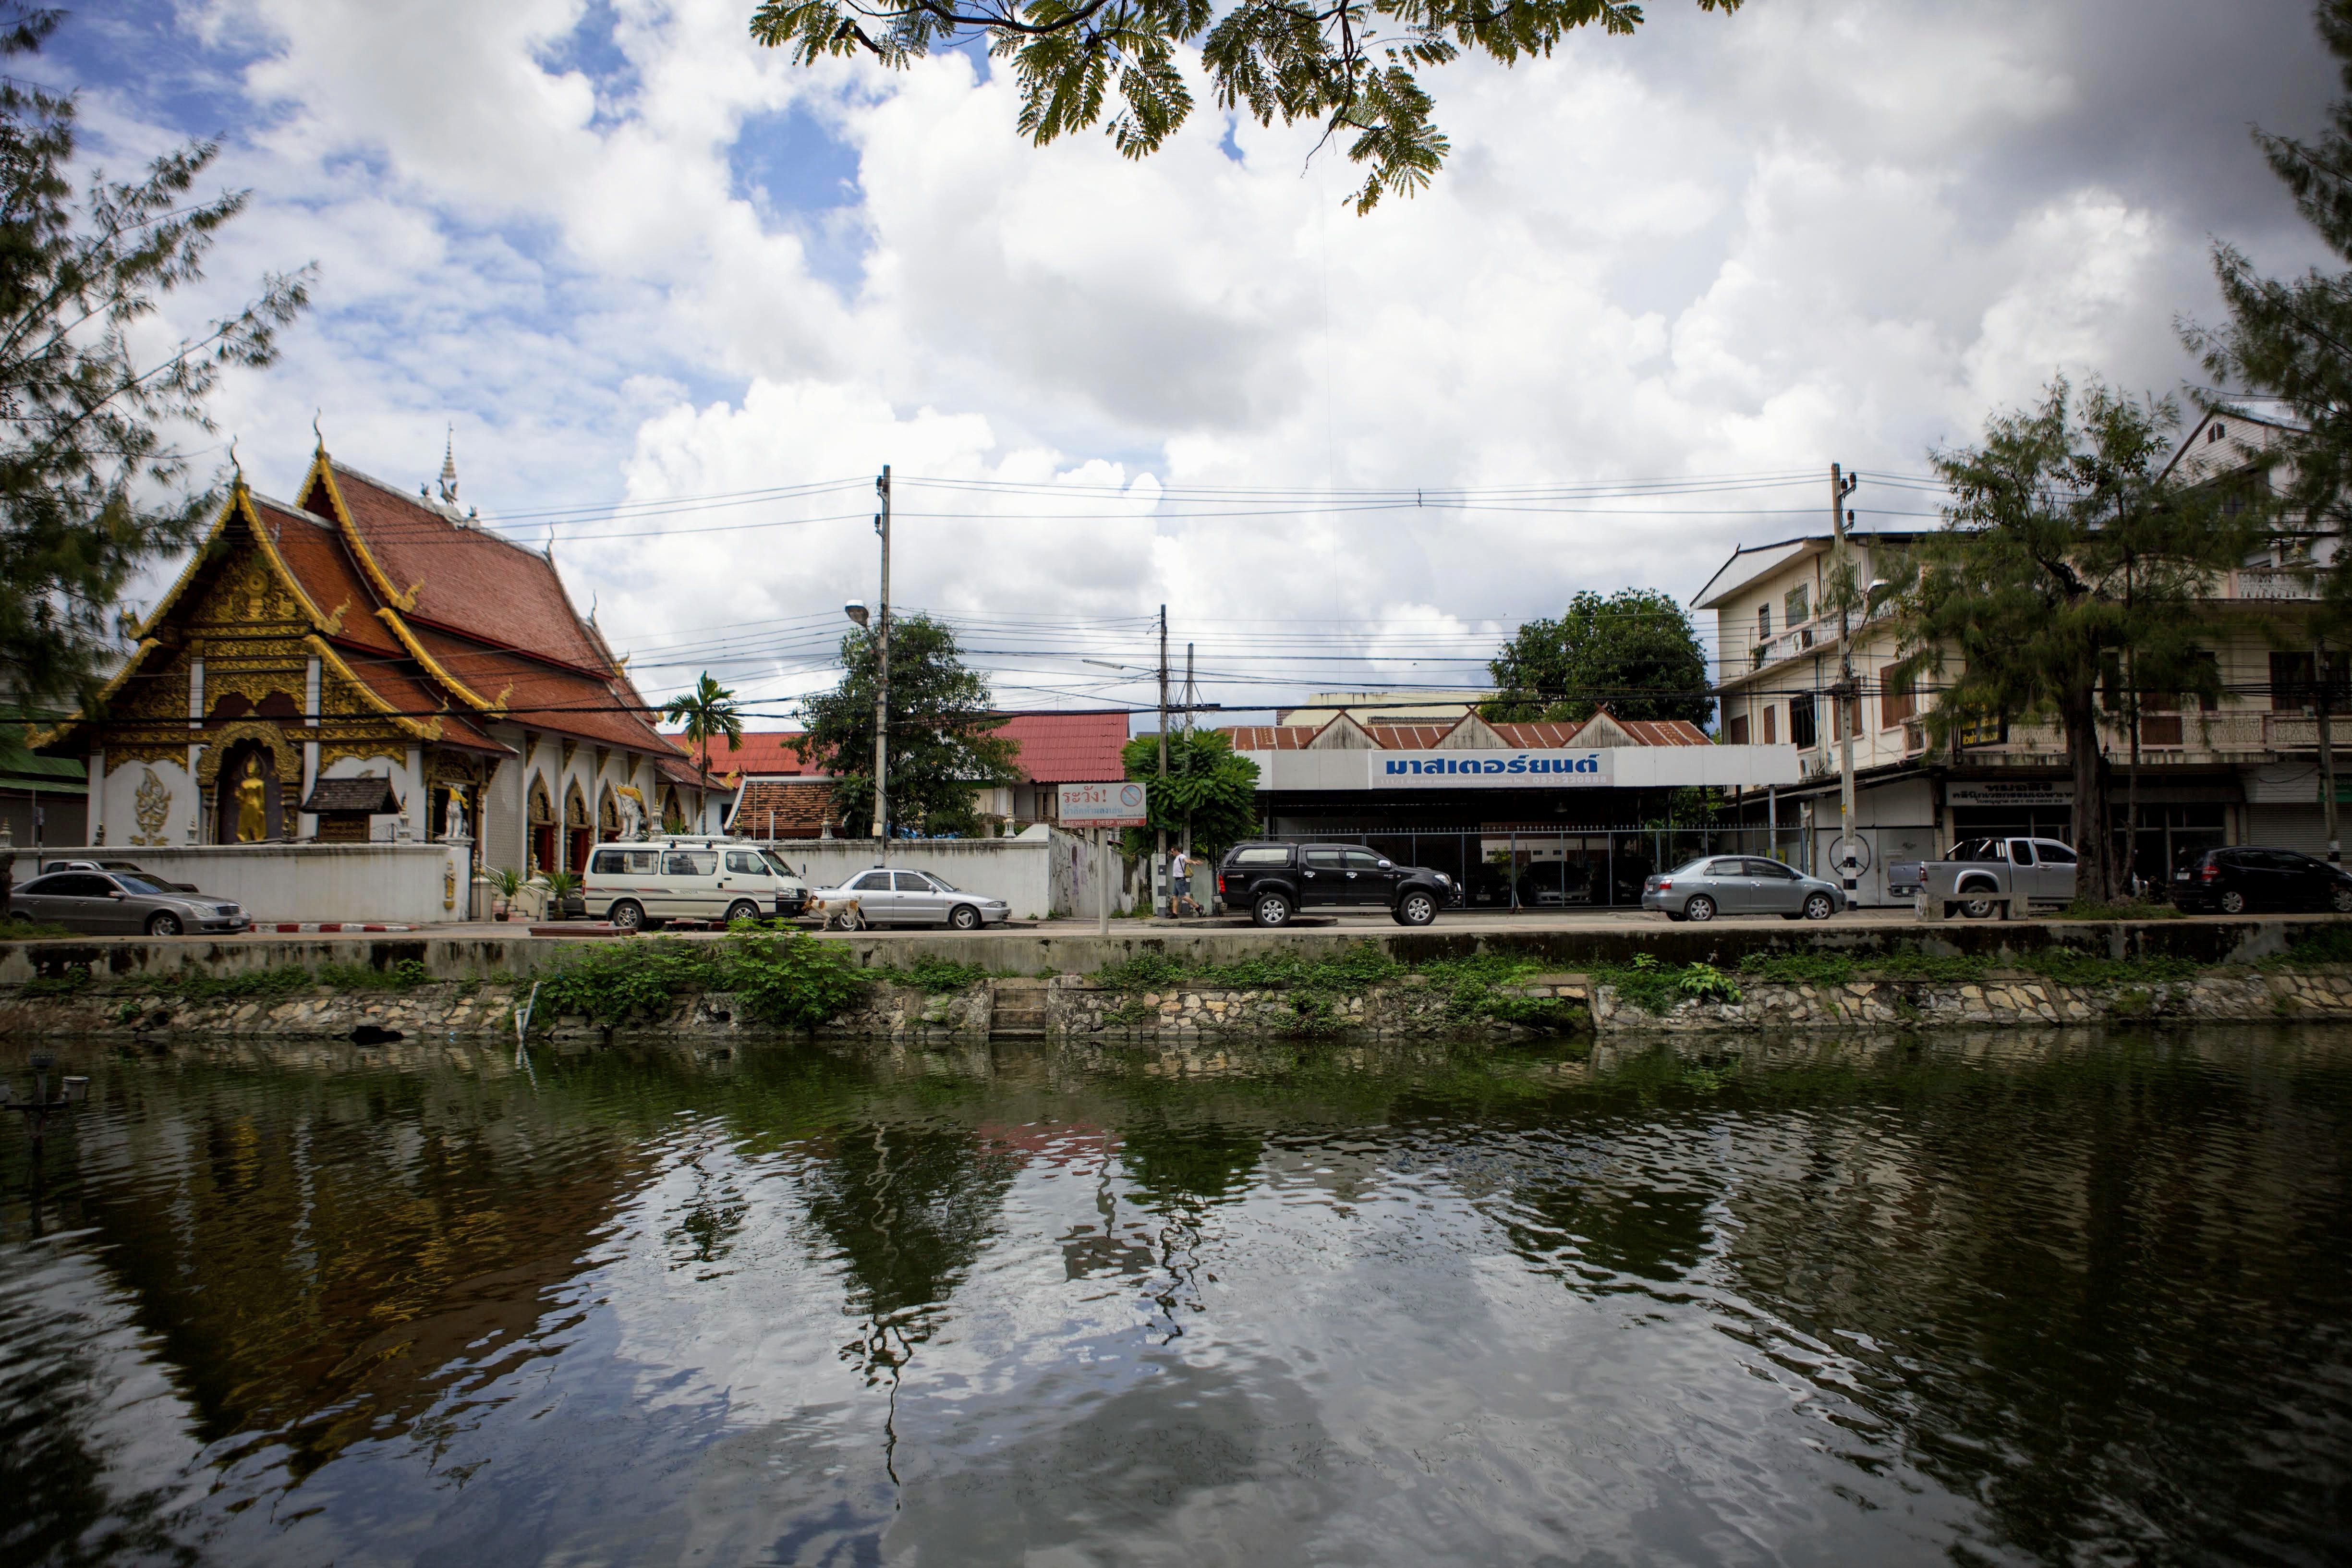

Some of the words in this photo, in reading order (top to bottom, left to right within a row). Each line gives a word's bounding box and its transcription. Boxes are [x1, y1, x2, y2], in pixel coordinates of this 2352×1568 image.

[1386, 754, 1600, 774] มาสเตอร์ยนต์
[1533, 776, 1607, 784] 053-220888
